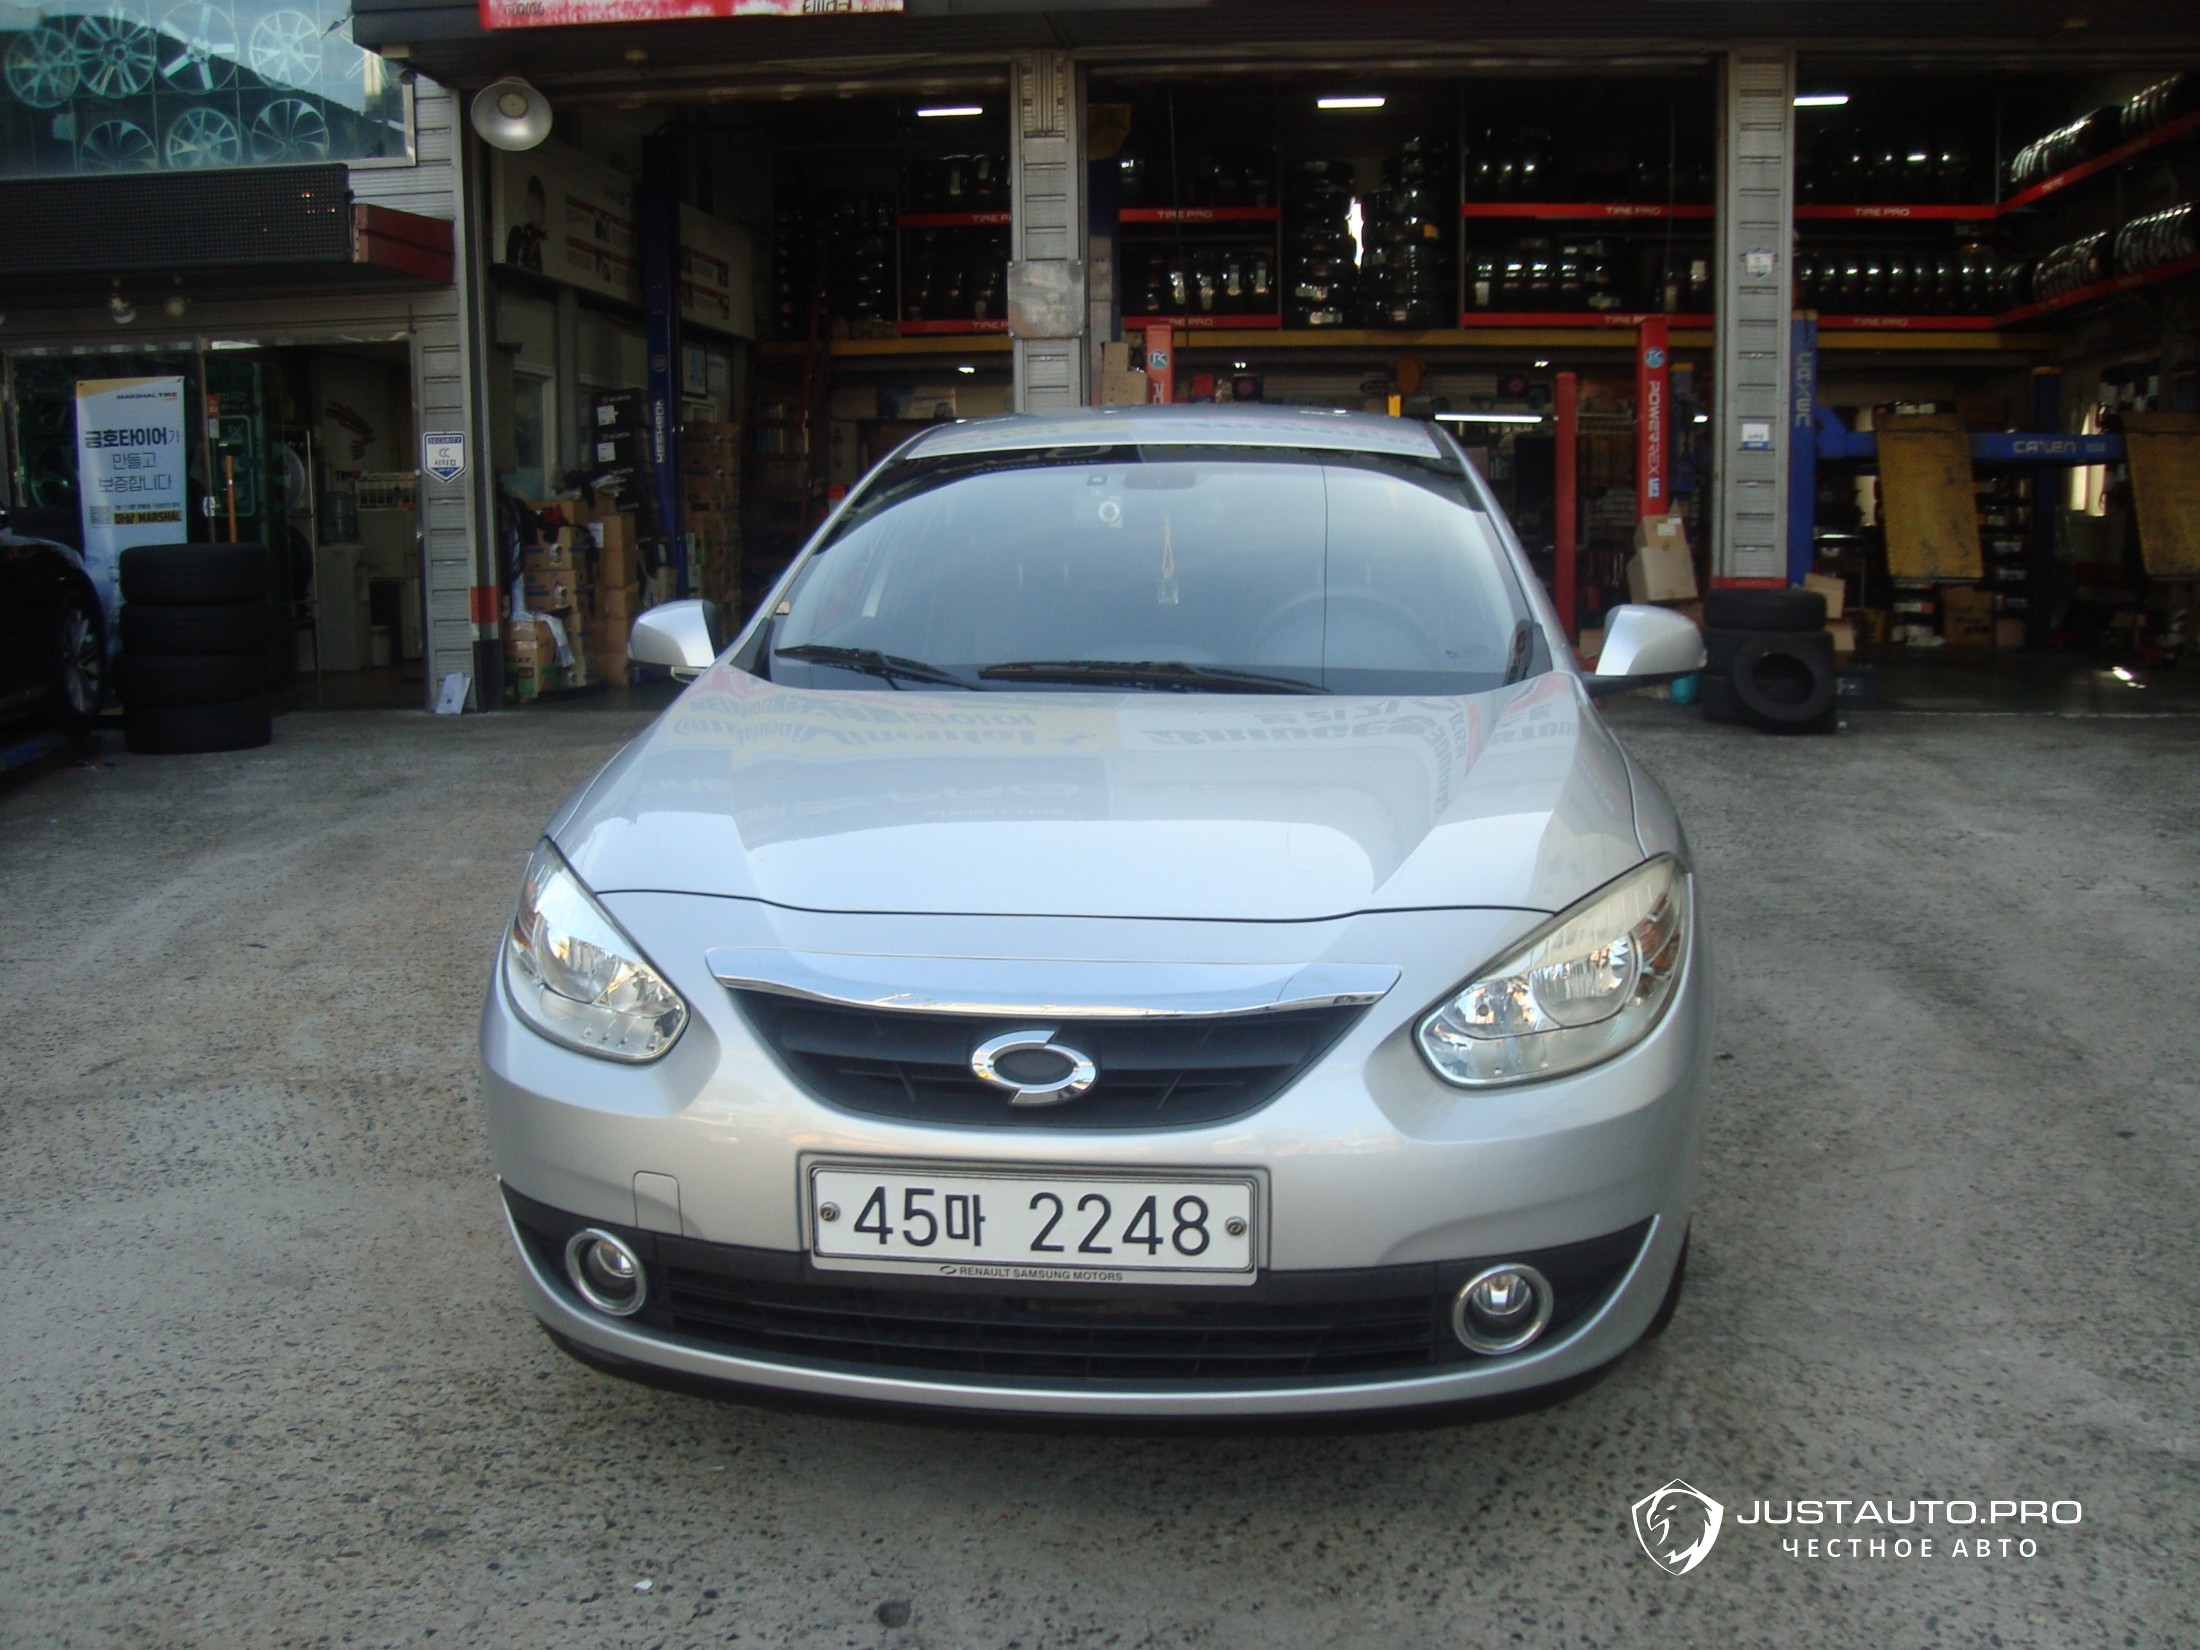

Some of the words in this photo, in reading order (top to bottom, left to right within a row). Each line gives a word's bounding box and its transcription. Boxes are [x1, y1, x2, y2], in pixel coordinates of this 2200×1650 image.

[85, 427, 179, 449] 금호타이어가
[112, 452, 157, 471] 만들고
[98, 474, 173, 494] 보증합니다
[138, 510, 181, 523] MARSHAL
[853, 1186, 986, 1248] 45마
[1029, 1191, 1211, 1256] 2248
[959, 1265, 1012, 1279] RENAULT
[1012, 1268, 1071, 1281] SAMSUNG
[1073, 1270, 1123, 1282] MOTORS
